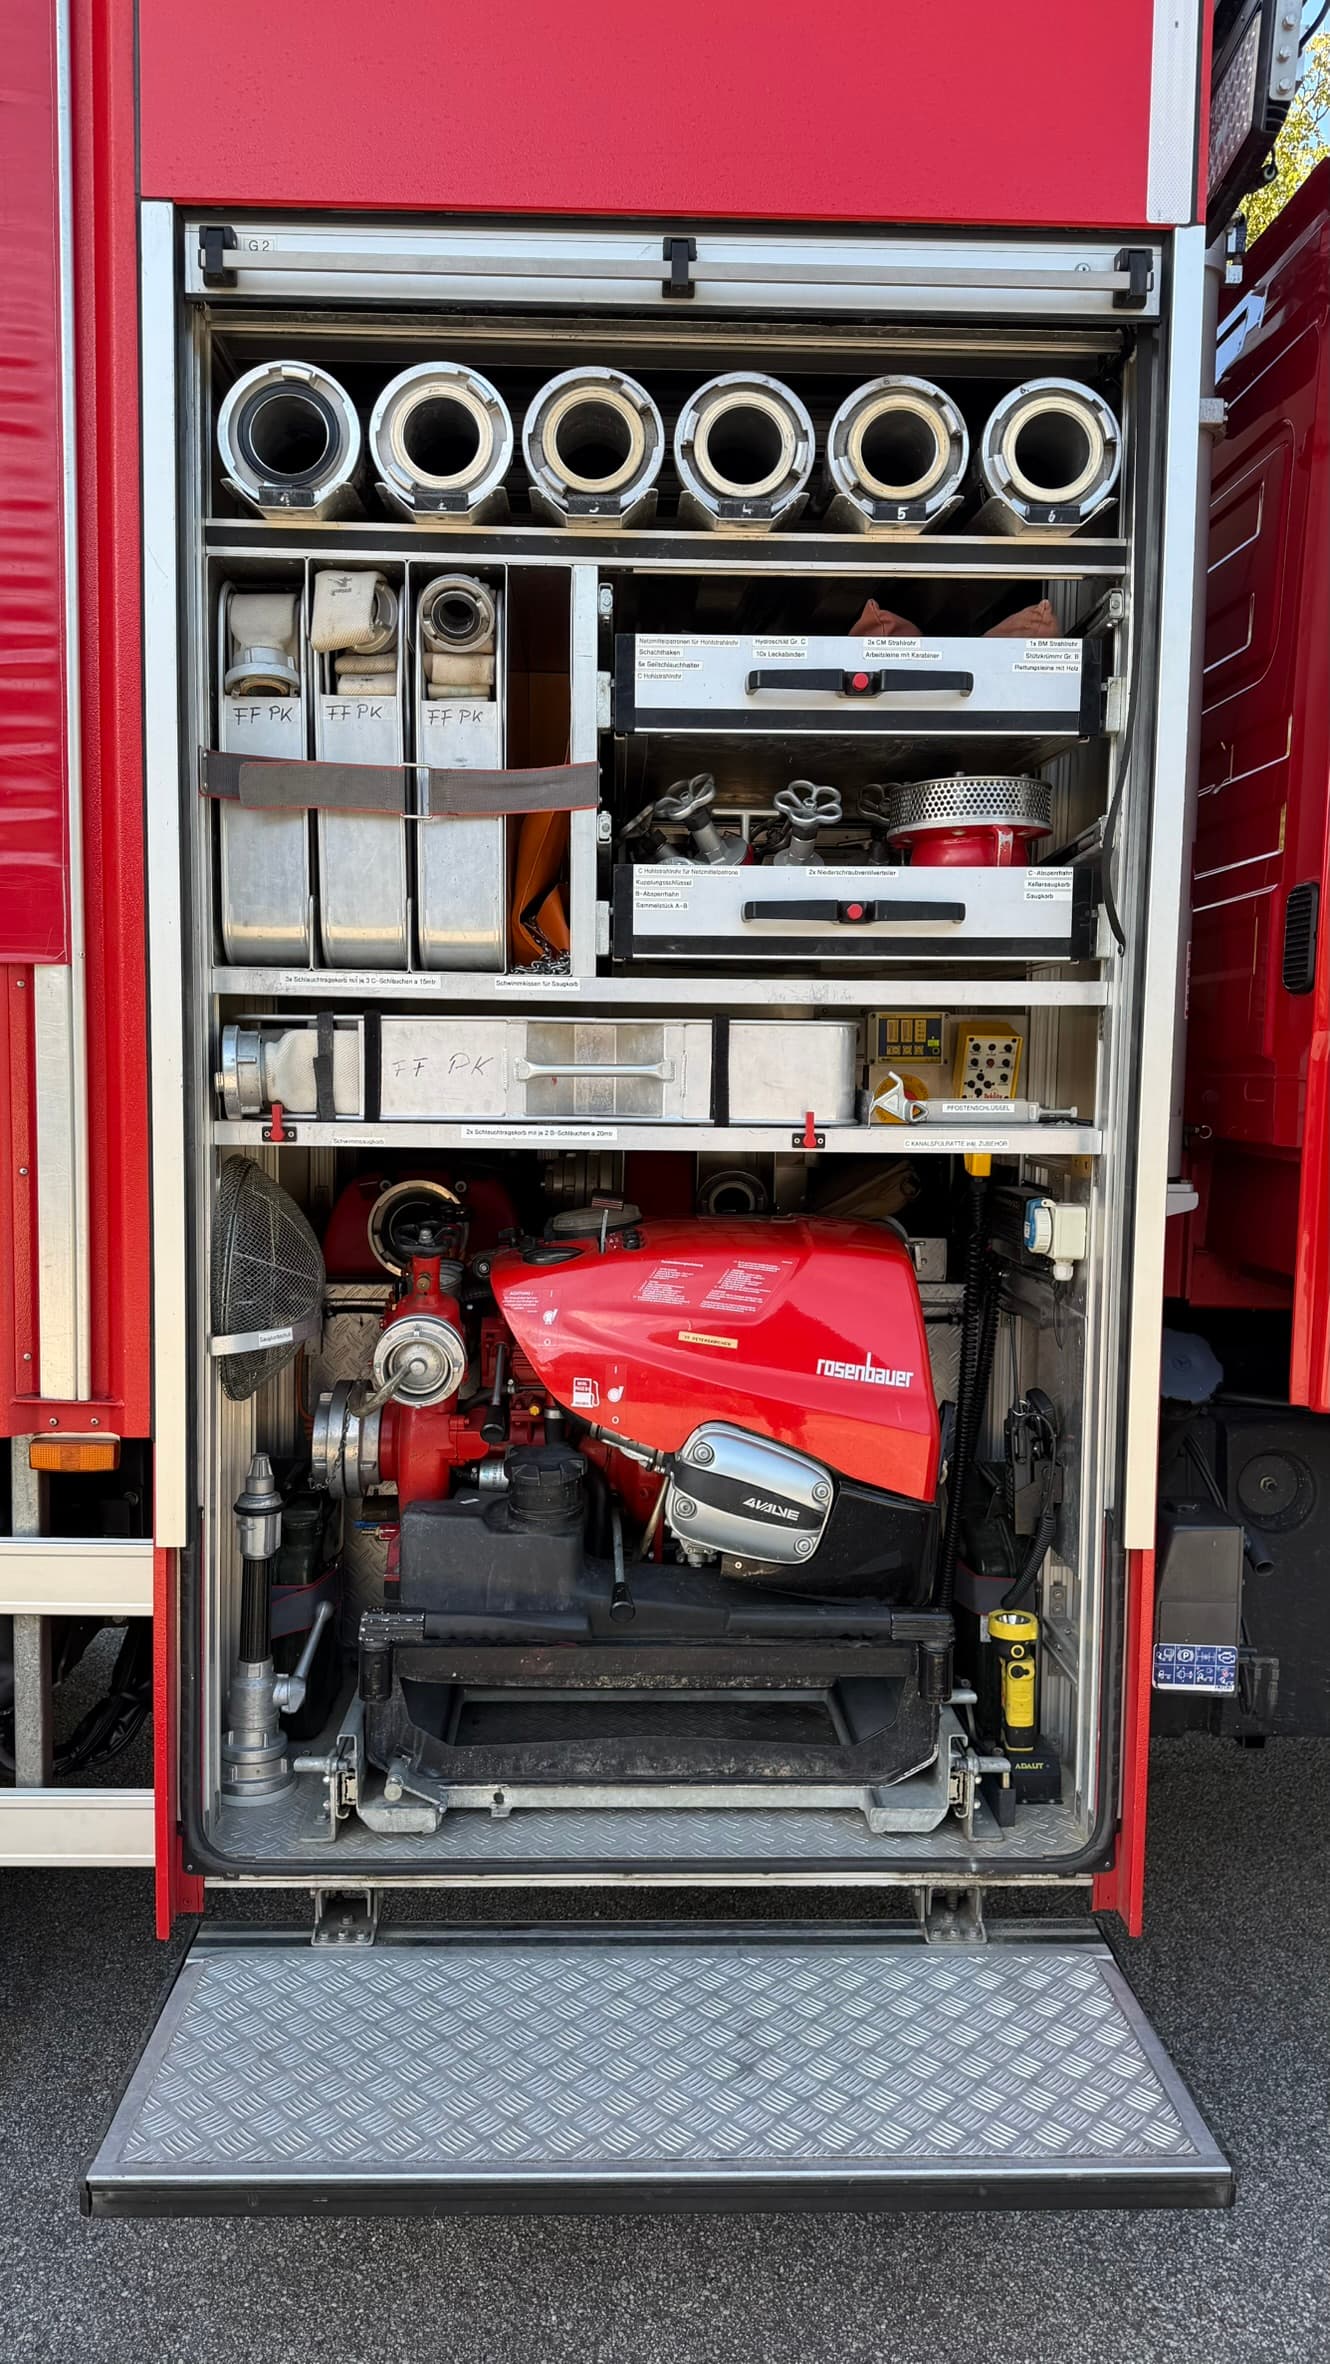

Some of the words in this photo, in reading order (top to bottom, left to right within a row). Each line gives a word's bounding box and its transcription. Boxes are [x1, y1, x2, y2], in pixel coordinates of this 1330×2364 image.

[248, 239, 259, 251] G
[262, 240, 270, 251] 2
[897, 506, 909, 520] 5
[1048, 509, 1056, 522] 6
[887, 639, 917, 647] Strahlrohr
[639, 648, 681, 656] Schachthaken
[233, 706, 261, 726] FF
[269, 705, 293, 722] PK
[325, 705, 351, 720] FF
[356, 703, 383, 719] PK
[427, 709, 454, 726] FF
[459, 709, 484, 724] PK
[638, 867, 643, 875] C
[635, 879, 692, 888] Kupplungsschlüssel
[1026, 892, 1054, 900] Saugkorb
[635, 901, 673, 909] Sammelstück
[551, 980, 579, 988] Saugkorb
[391, 1057, 429, 1077] FF
[447, 1052, 494, 1076] PK
[946, 1104, 1010, 1112] PFOSTENSCHLÜSSEL
[816, 1352, 914, 1387] rosenbauer
[742, 1497, 800, 1521] 4VALVE
